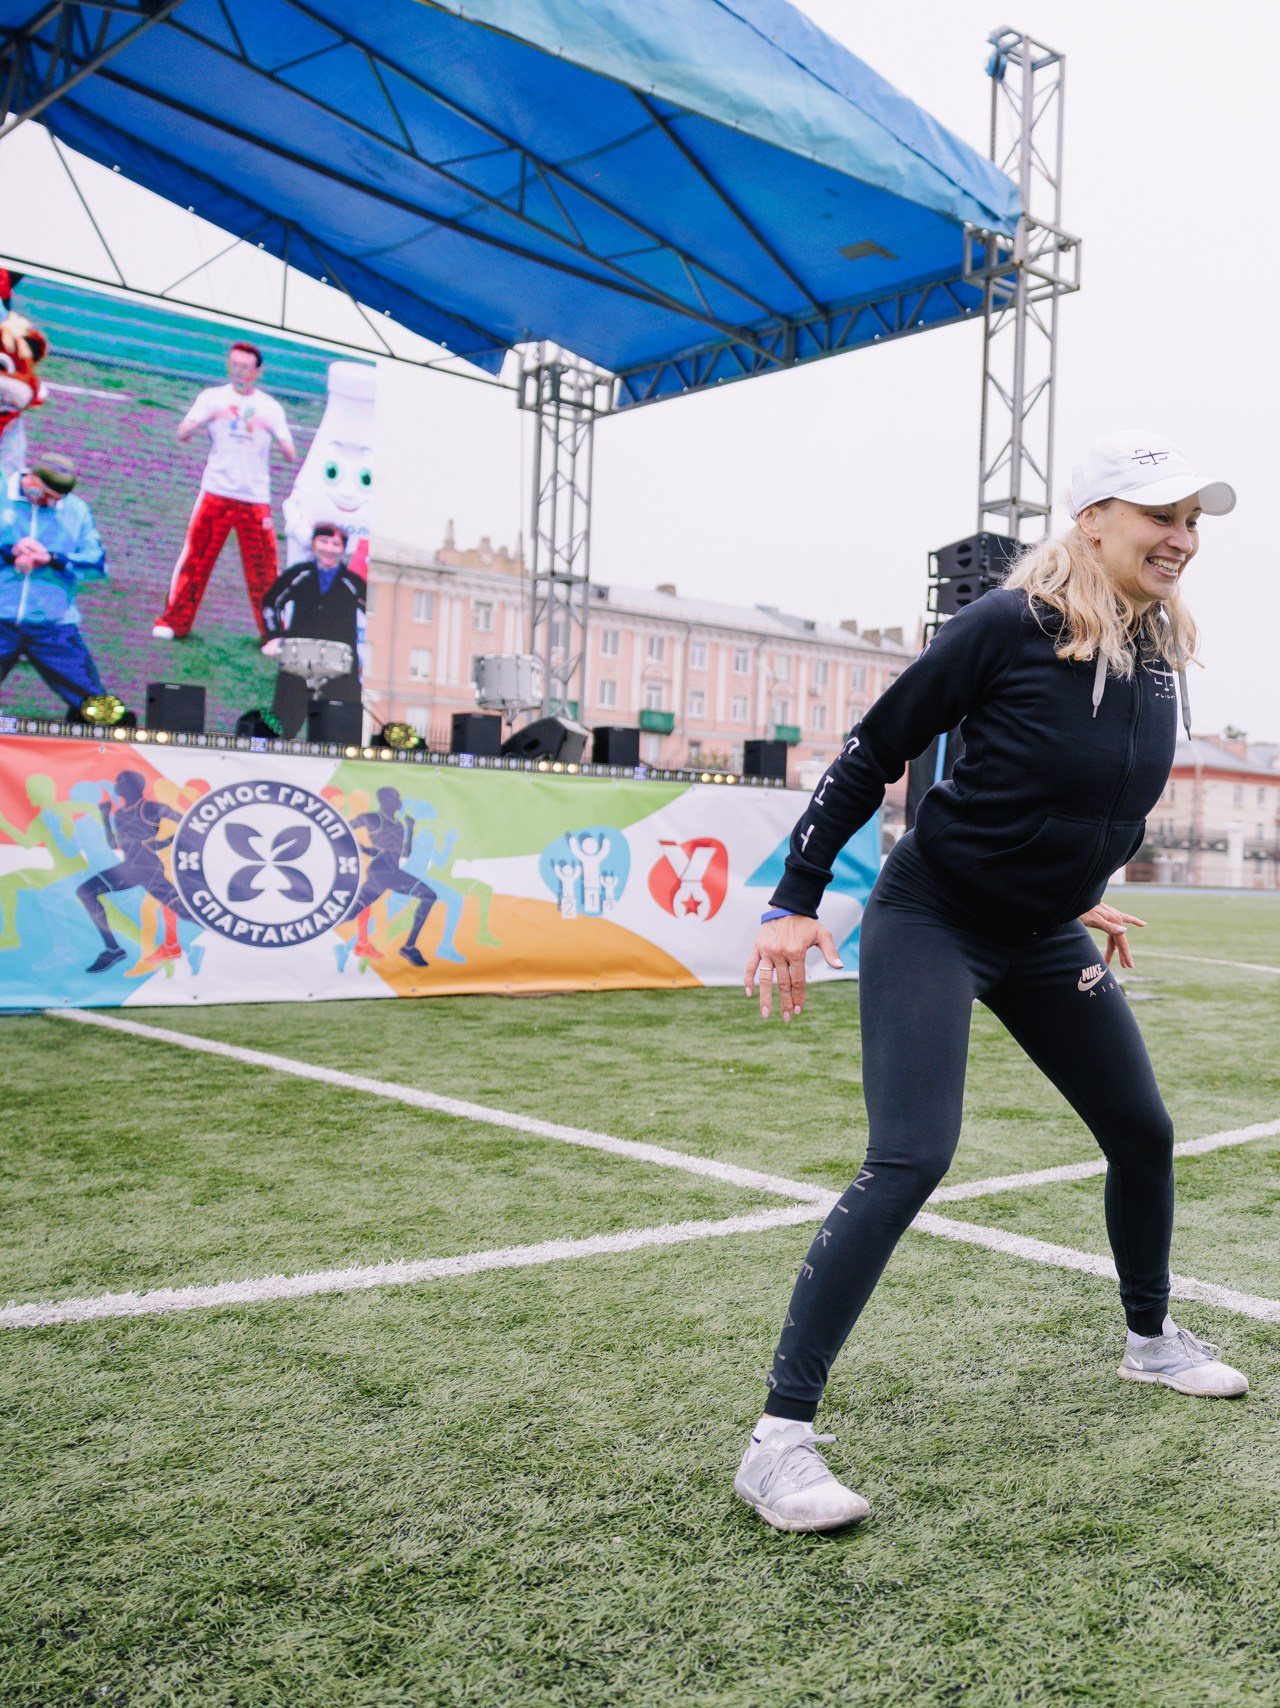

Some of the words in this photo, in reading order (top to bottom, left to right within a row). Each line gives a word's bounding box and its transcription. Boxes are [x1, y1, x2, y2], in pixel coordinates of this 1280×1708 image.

[188, 784, 271, 835] КОМОС
[277, 786, 347, 840] ГРУПП
[192, 889, 351, 944] СПАРТАКИАДА
[1082, 963, 1102, 982] NIKE
[1089, 982, 1116, 998] AIR
[802, 1168, 876, 1280] NIKE
